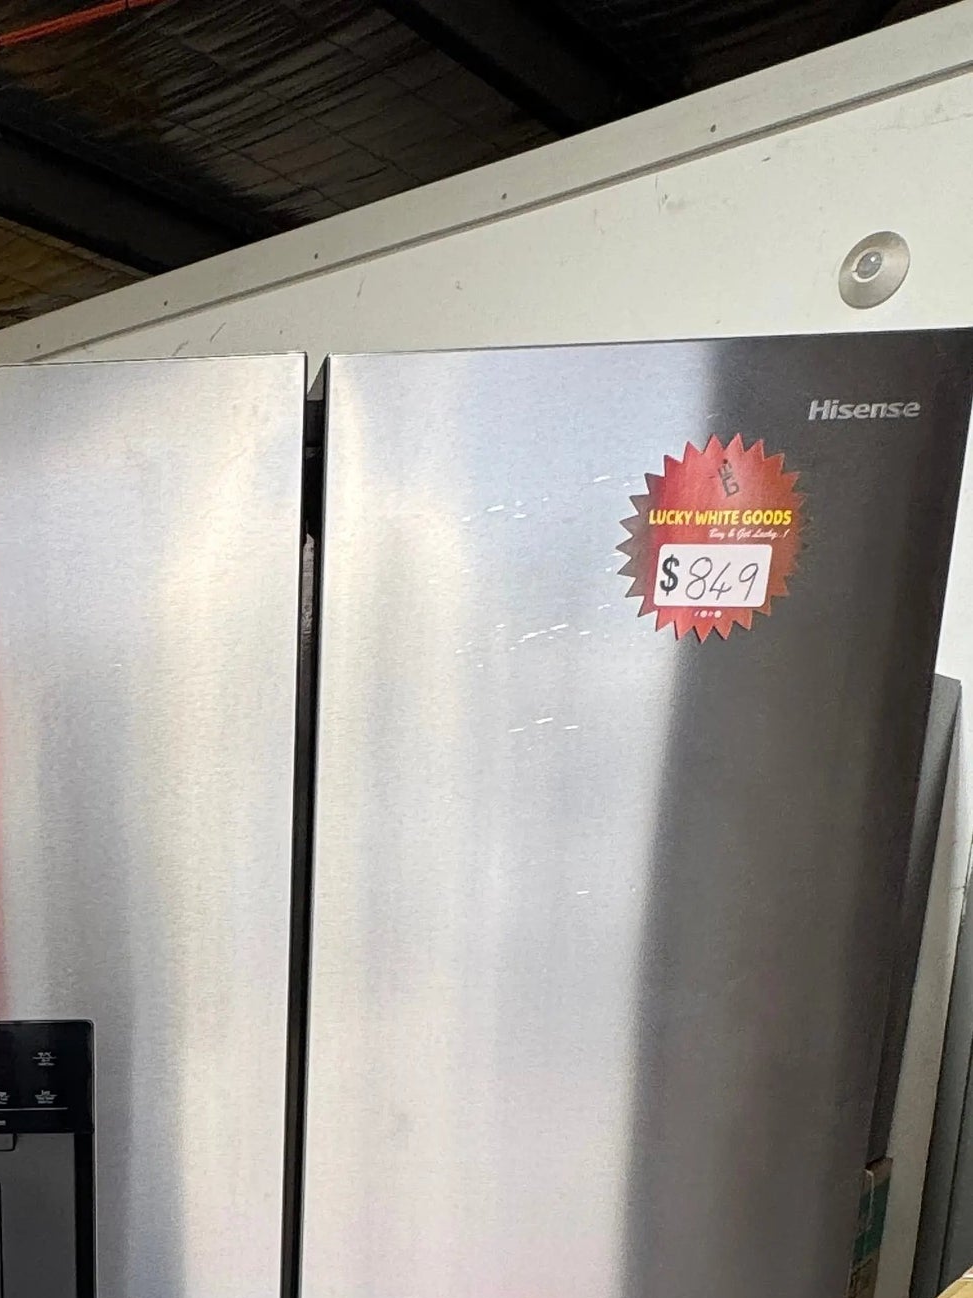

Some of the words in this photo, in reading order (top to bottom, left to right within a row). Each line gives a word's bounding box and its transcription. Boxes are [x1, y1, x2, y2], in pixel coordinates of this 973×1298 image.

[808, 399, 921, 420] Hisense
[649, 509, 692, 525] LUCKY
[695, 509, 738, 525] WHITE
[742, 510, 792, 526] GOODS
